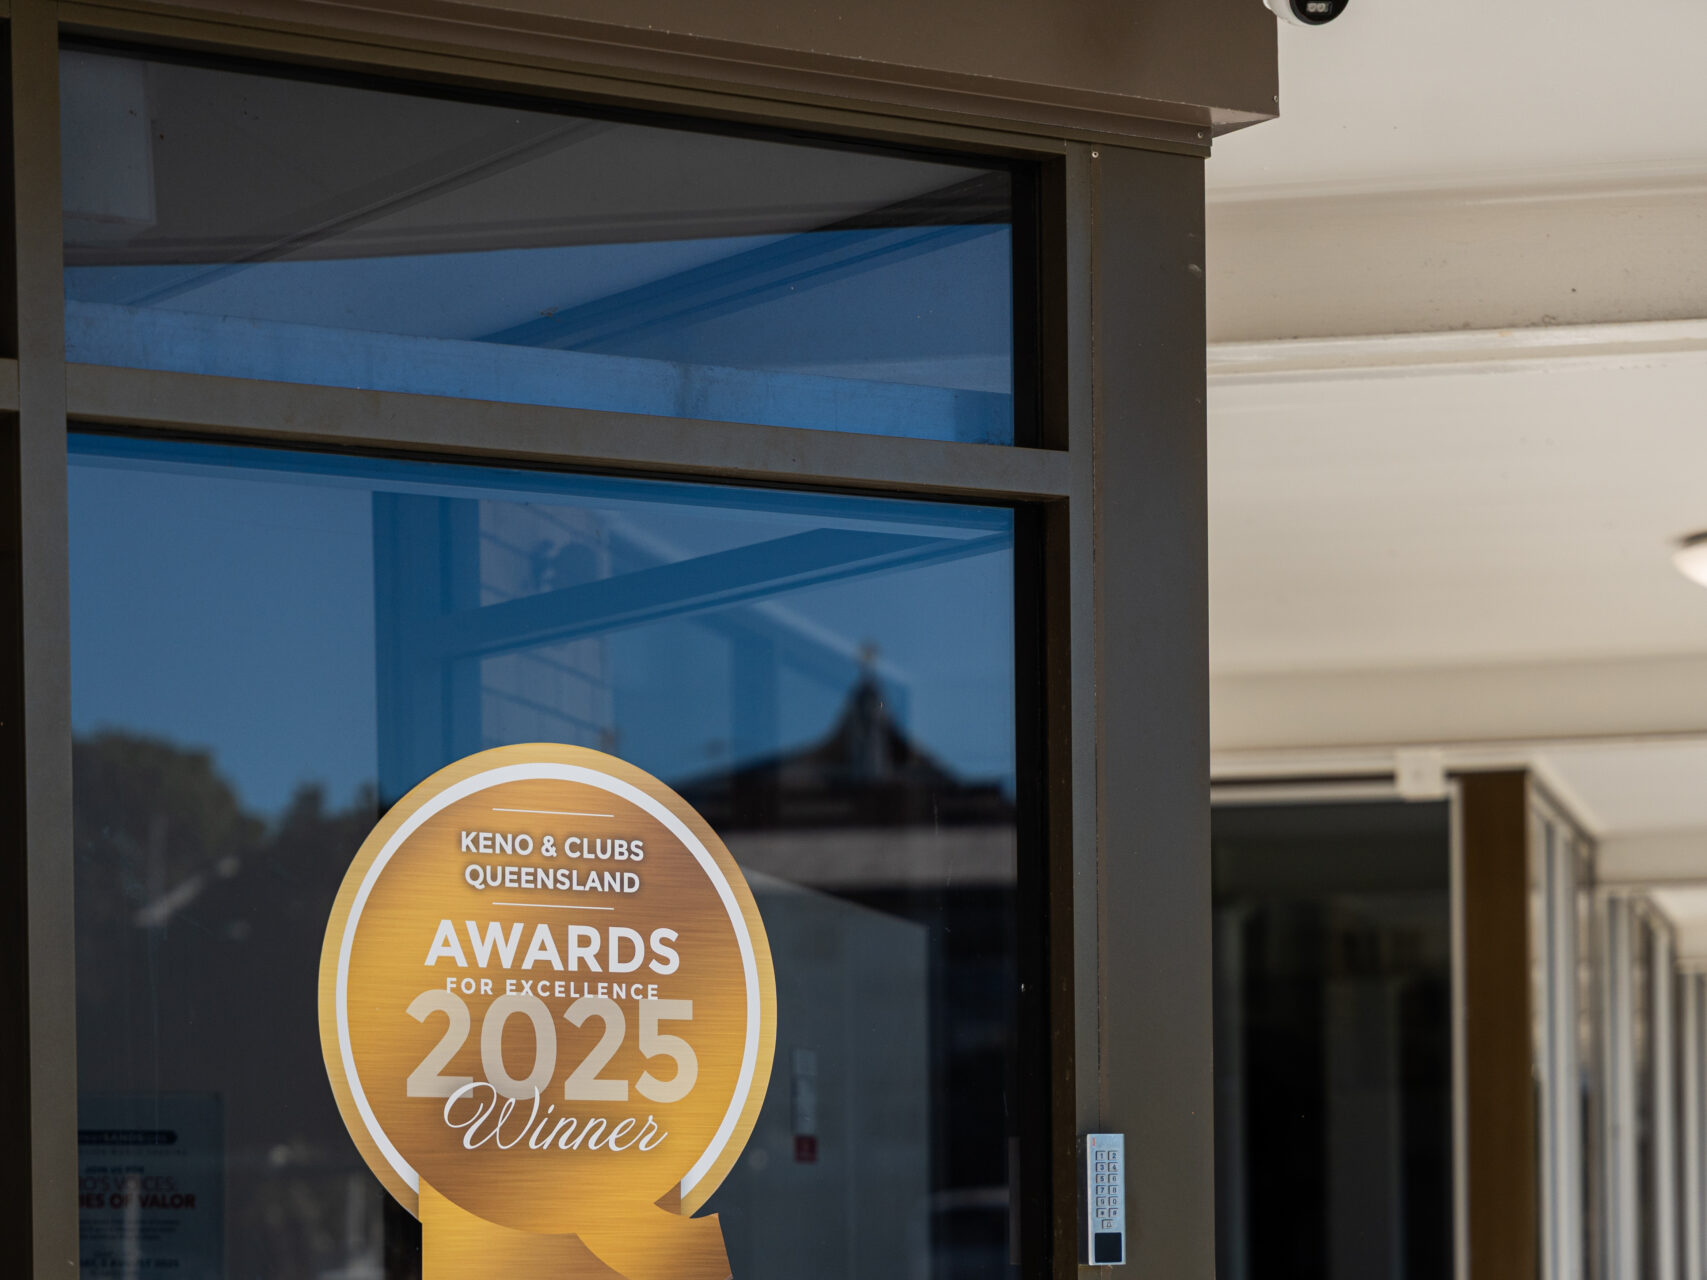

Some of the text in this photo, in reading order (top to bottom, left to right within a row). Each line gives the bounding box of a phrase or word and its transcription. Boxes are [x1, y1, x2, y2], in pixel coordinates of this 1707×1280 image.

[461, 831, 644, 861] KENO & CLUBS
[464, 863, 640, 893] QUEENSLAND
[424, 919, 680, 975] AWARDS
[446, 977, 659, 1000] FOR EXCELLENCE
[405, 989, 699, 1103] 2025
[443, 1081, 668, 1152] Winner
[138, 1193, 196, 1209] VALOR
